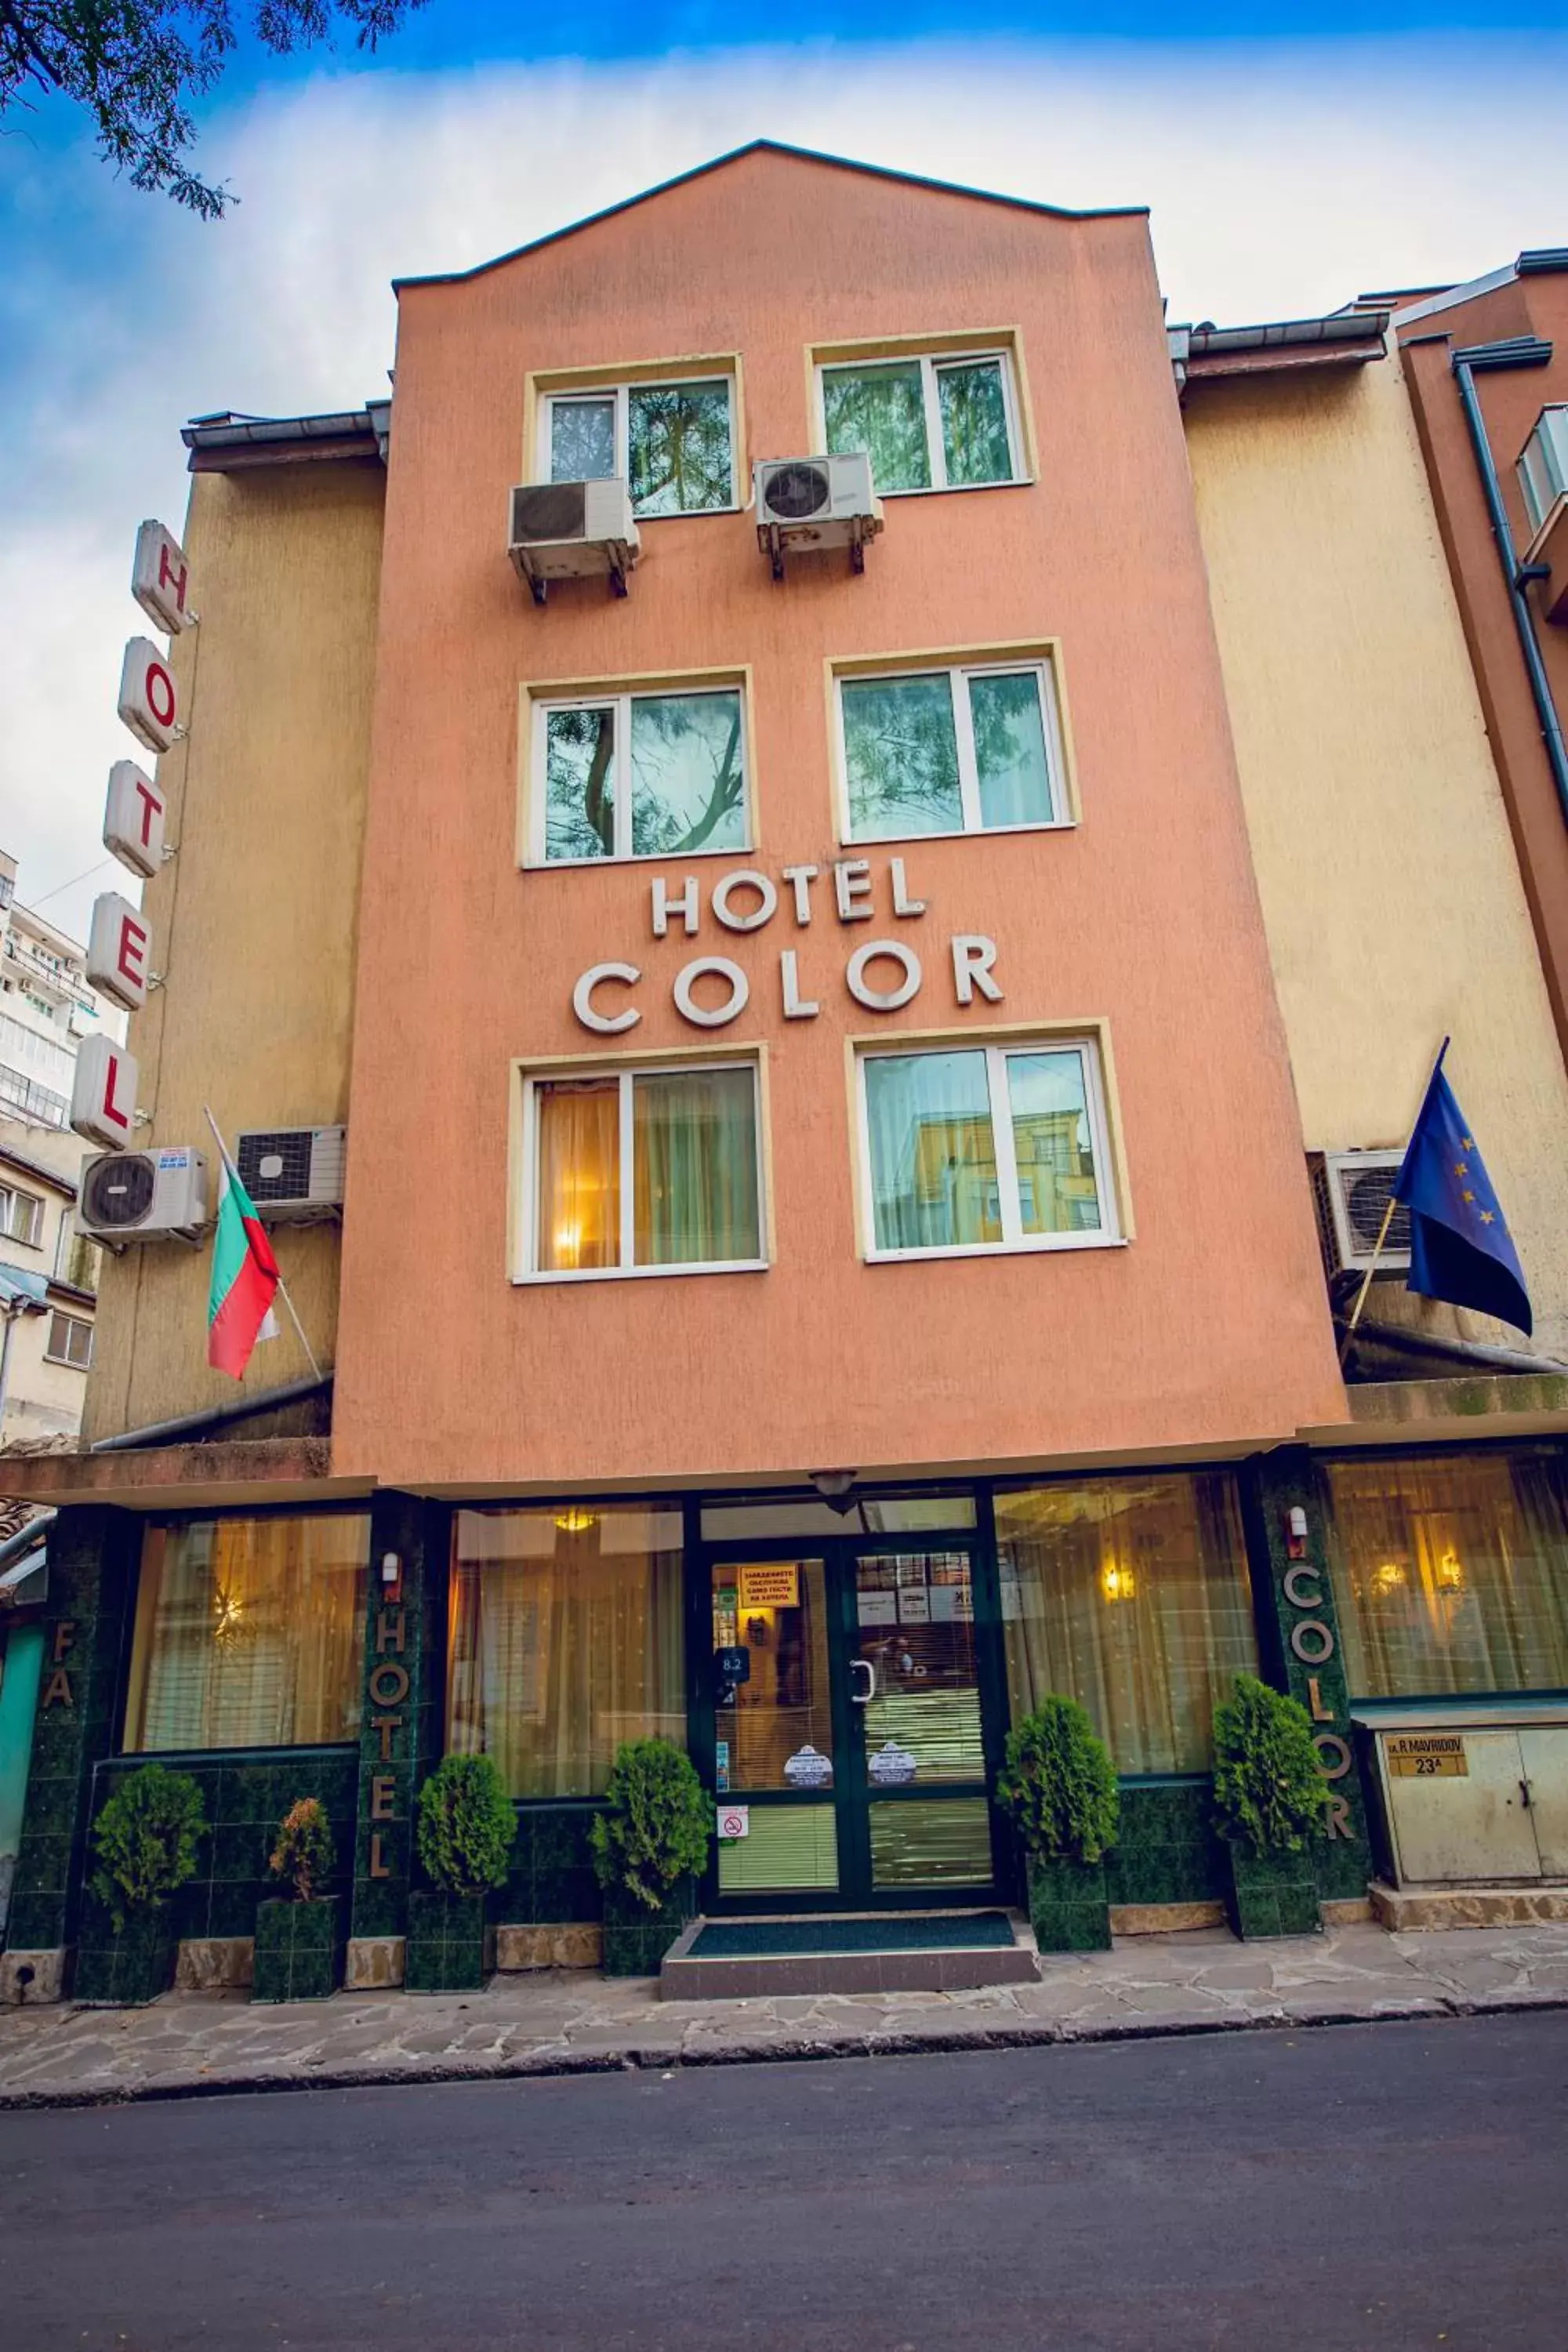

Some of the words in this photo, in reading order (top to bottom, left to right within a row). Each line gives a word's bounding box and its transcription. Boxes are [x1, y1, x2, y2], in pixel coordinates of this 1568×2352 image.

[103, 543, 188, 1144] HOTEL
[651, 857, 927, 938] HOTEL
[573, 935, 1004, 1033] COLOR
[369, 1613, 409, 1878] HOTEL
[723, 1658, 742, 1671] 8.2
[1283, 1566, 1355, 1840] COLOR
